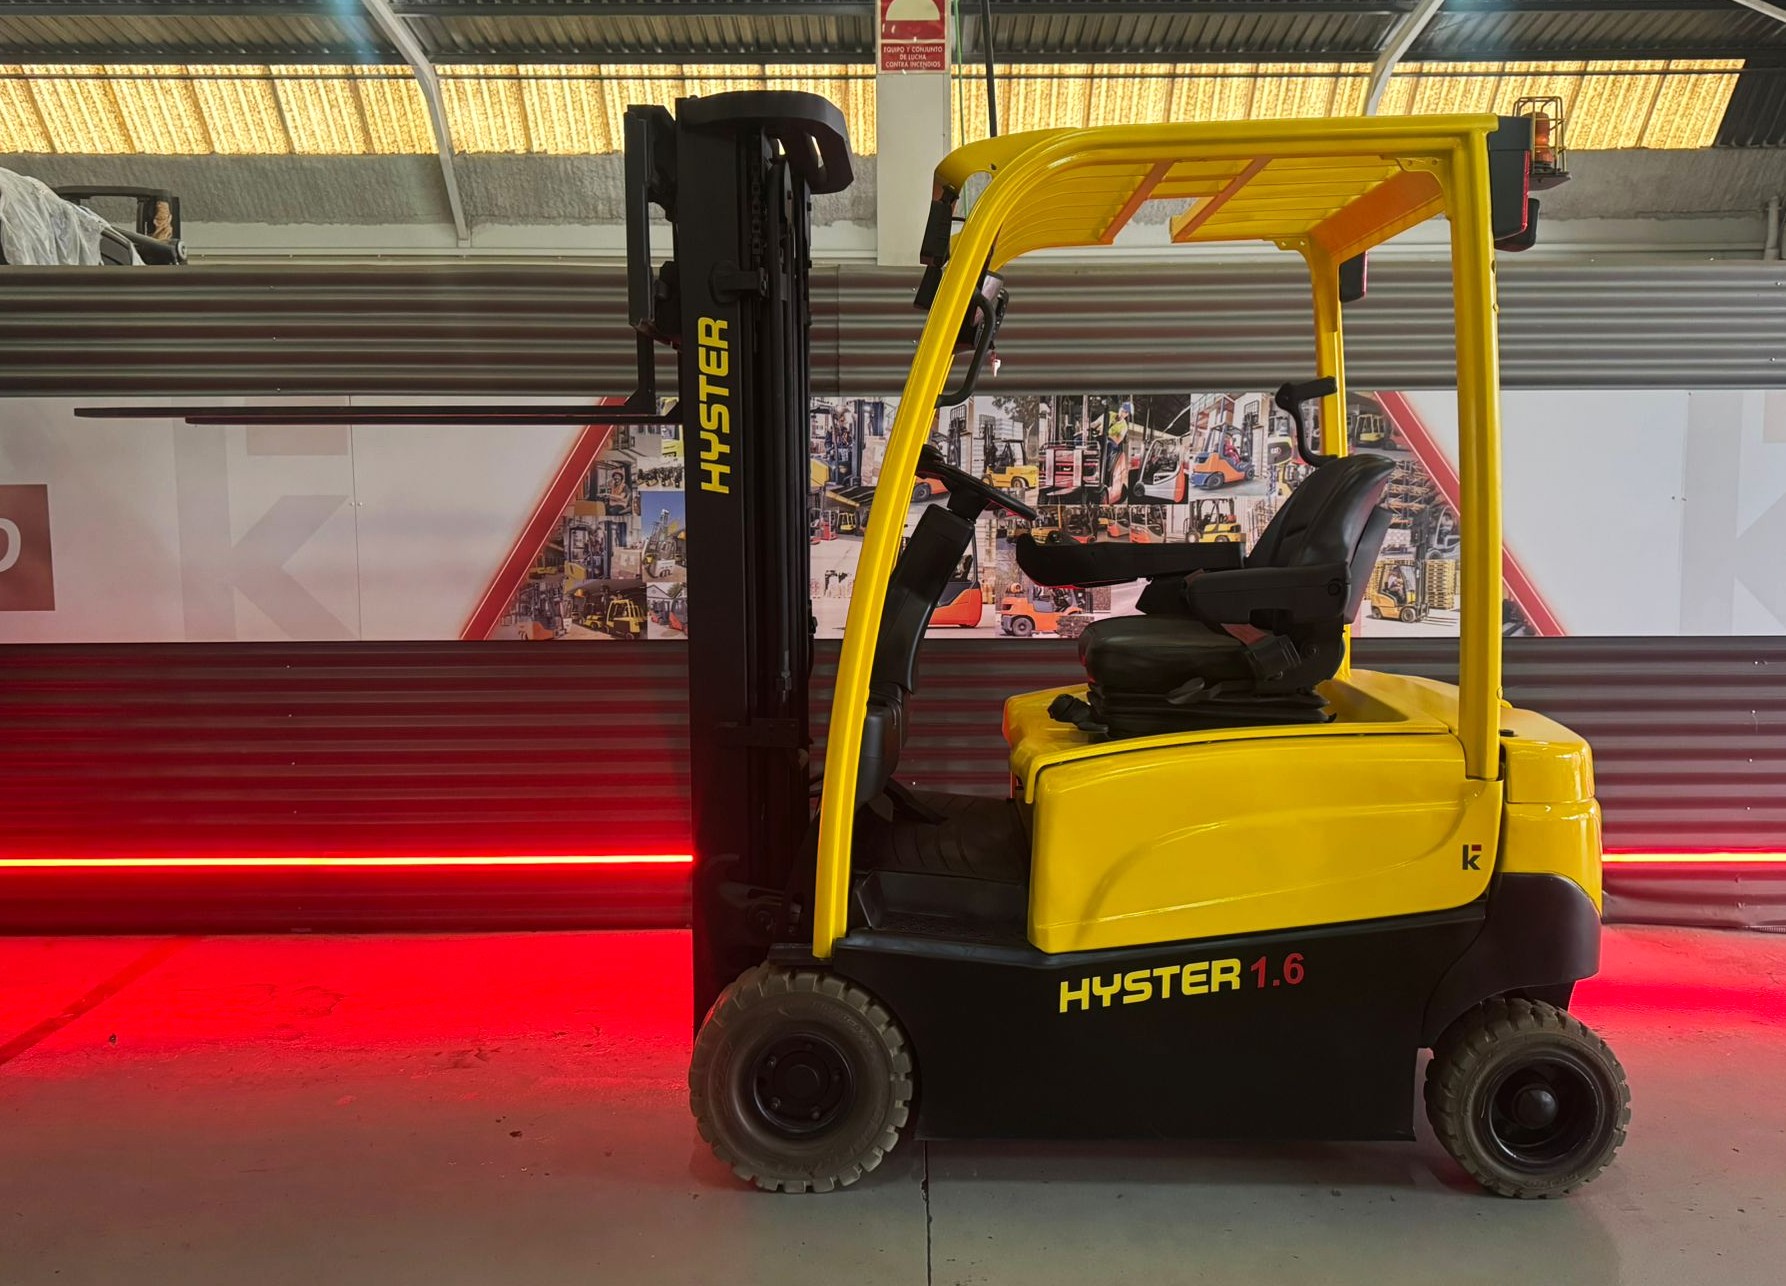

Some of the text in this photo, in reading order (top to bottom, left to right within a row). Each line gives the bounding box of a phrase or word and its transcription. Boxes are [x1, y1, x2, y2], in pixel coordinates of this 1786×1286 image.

[697, 316, 731, 494] HYSTER
[1059, 952, 1305, 1014] HYSTER 1.6
